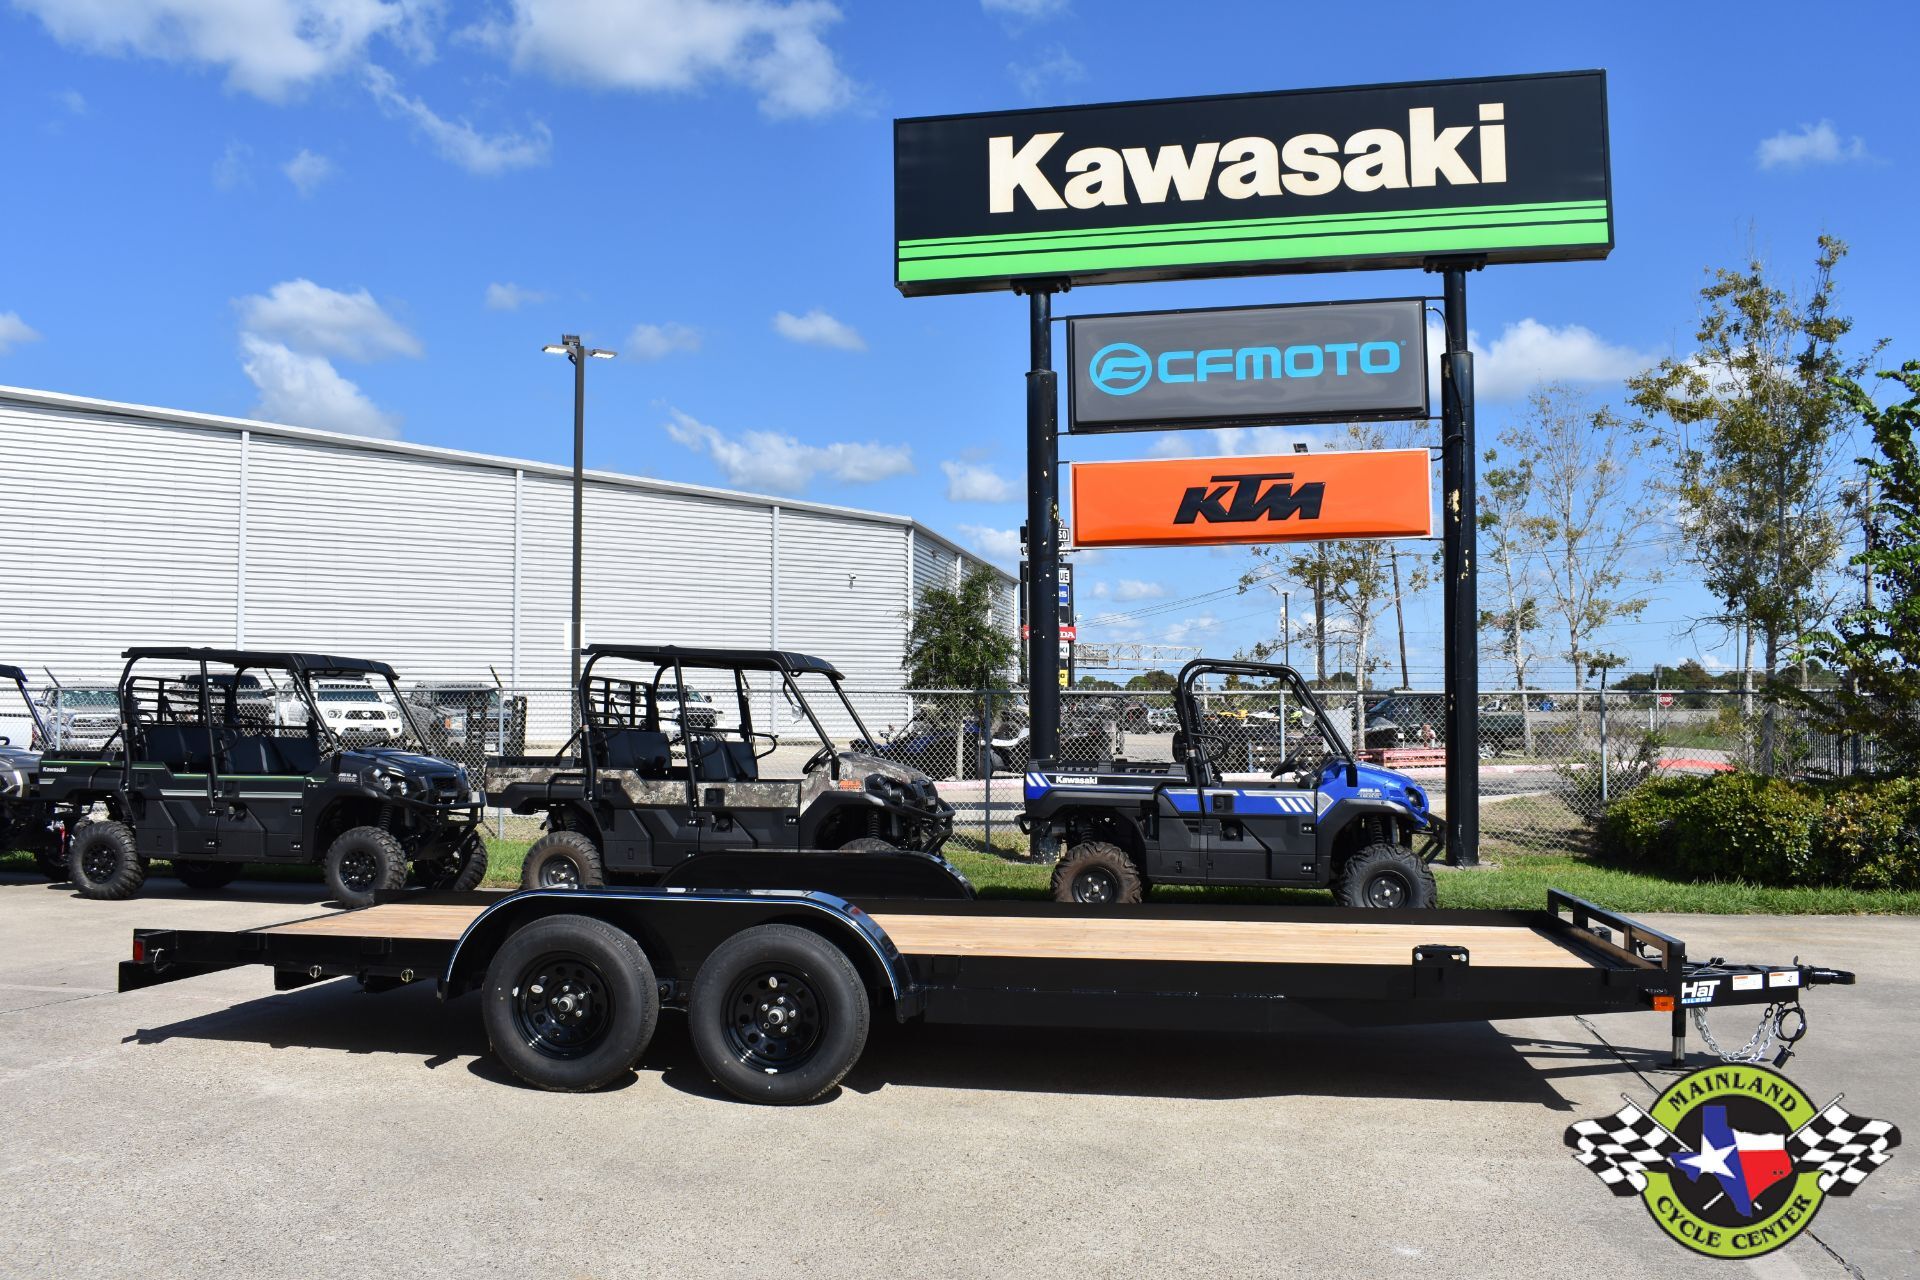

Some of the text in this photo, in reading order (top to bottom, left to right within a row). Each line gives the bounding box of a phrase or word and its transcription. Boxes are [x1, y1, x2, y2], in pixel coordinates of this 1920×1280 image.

[989, 103, 1507, 214] Kawasaki
[1158, 341, 1400, 383] CFMOTO
[1173, 472, 1326, 524] KTM
[1055, 775, 1098, 785] Kawasaki
